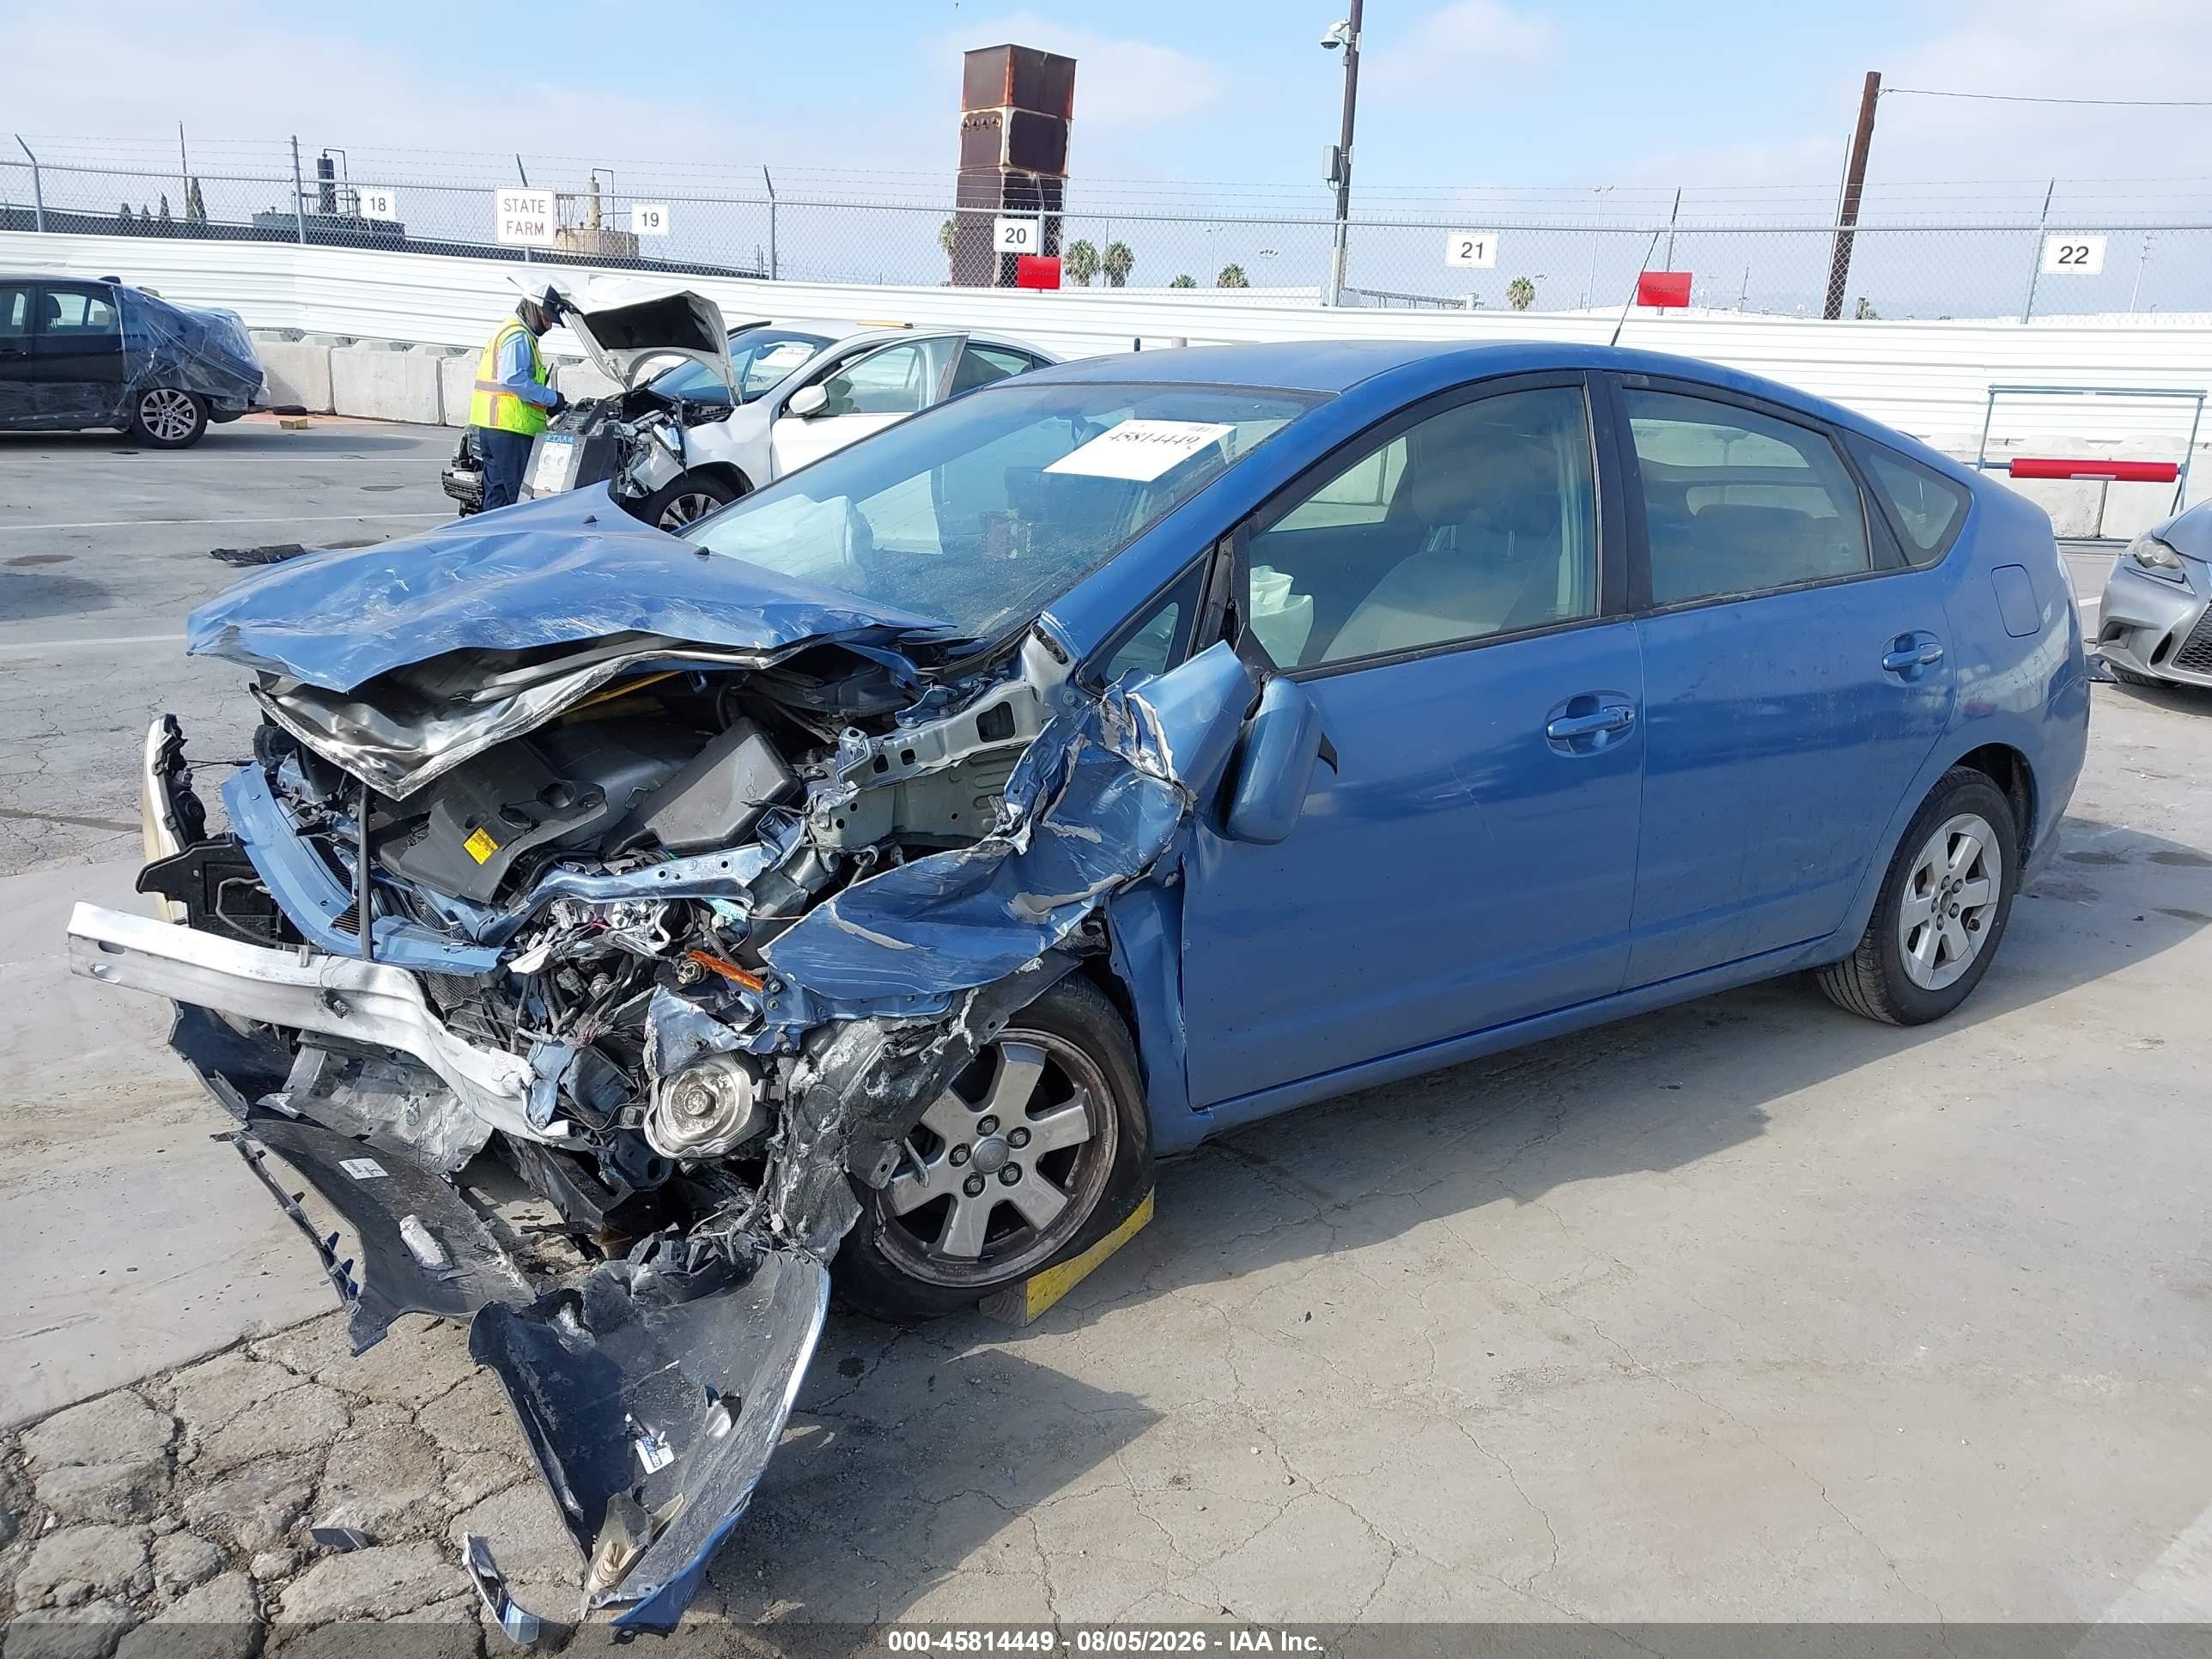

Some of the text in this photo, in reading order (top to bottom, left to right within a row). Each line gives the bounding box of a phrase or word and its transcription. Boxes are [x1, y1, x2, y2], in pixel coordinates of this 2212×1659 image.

[368, 197, 386, 212] 18
[503, 198, 547, 214] STATE
[507, 220, 544, 236] FARM
[641, 211, 659, 228] 19
[1005, 227, 1027, 245] 20
[1460, 241, 1484, 259] 21
[2057, 246, 2090, 264] 22
